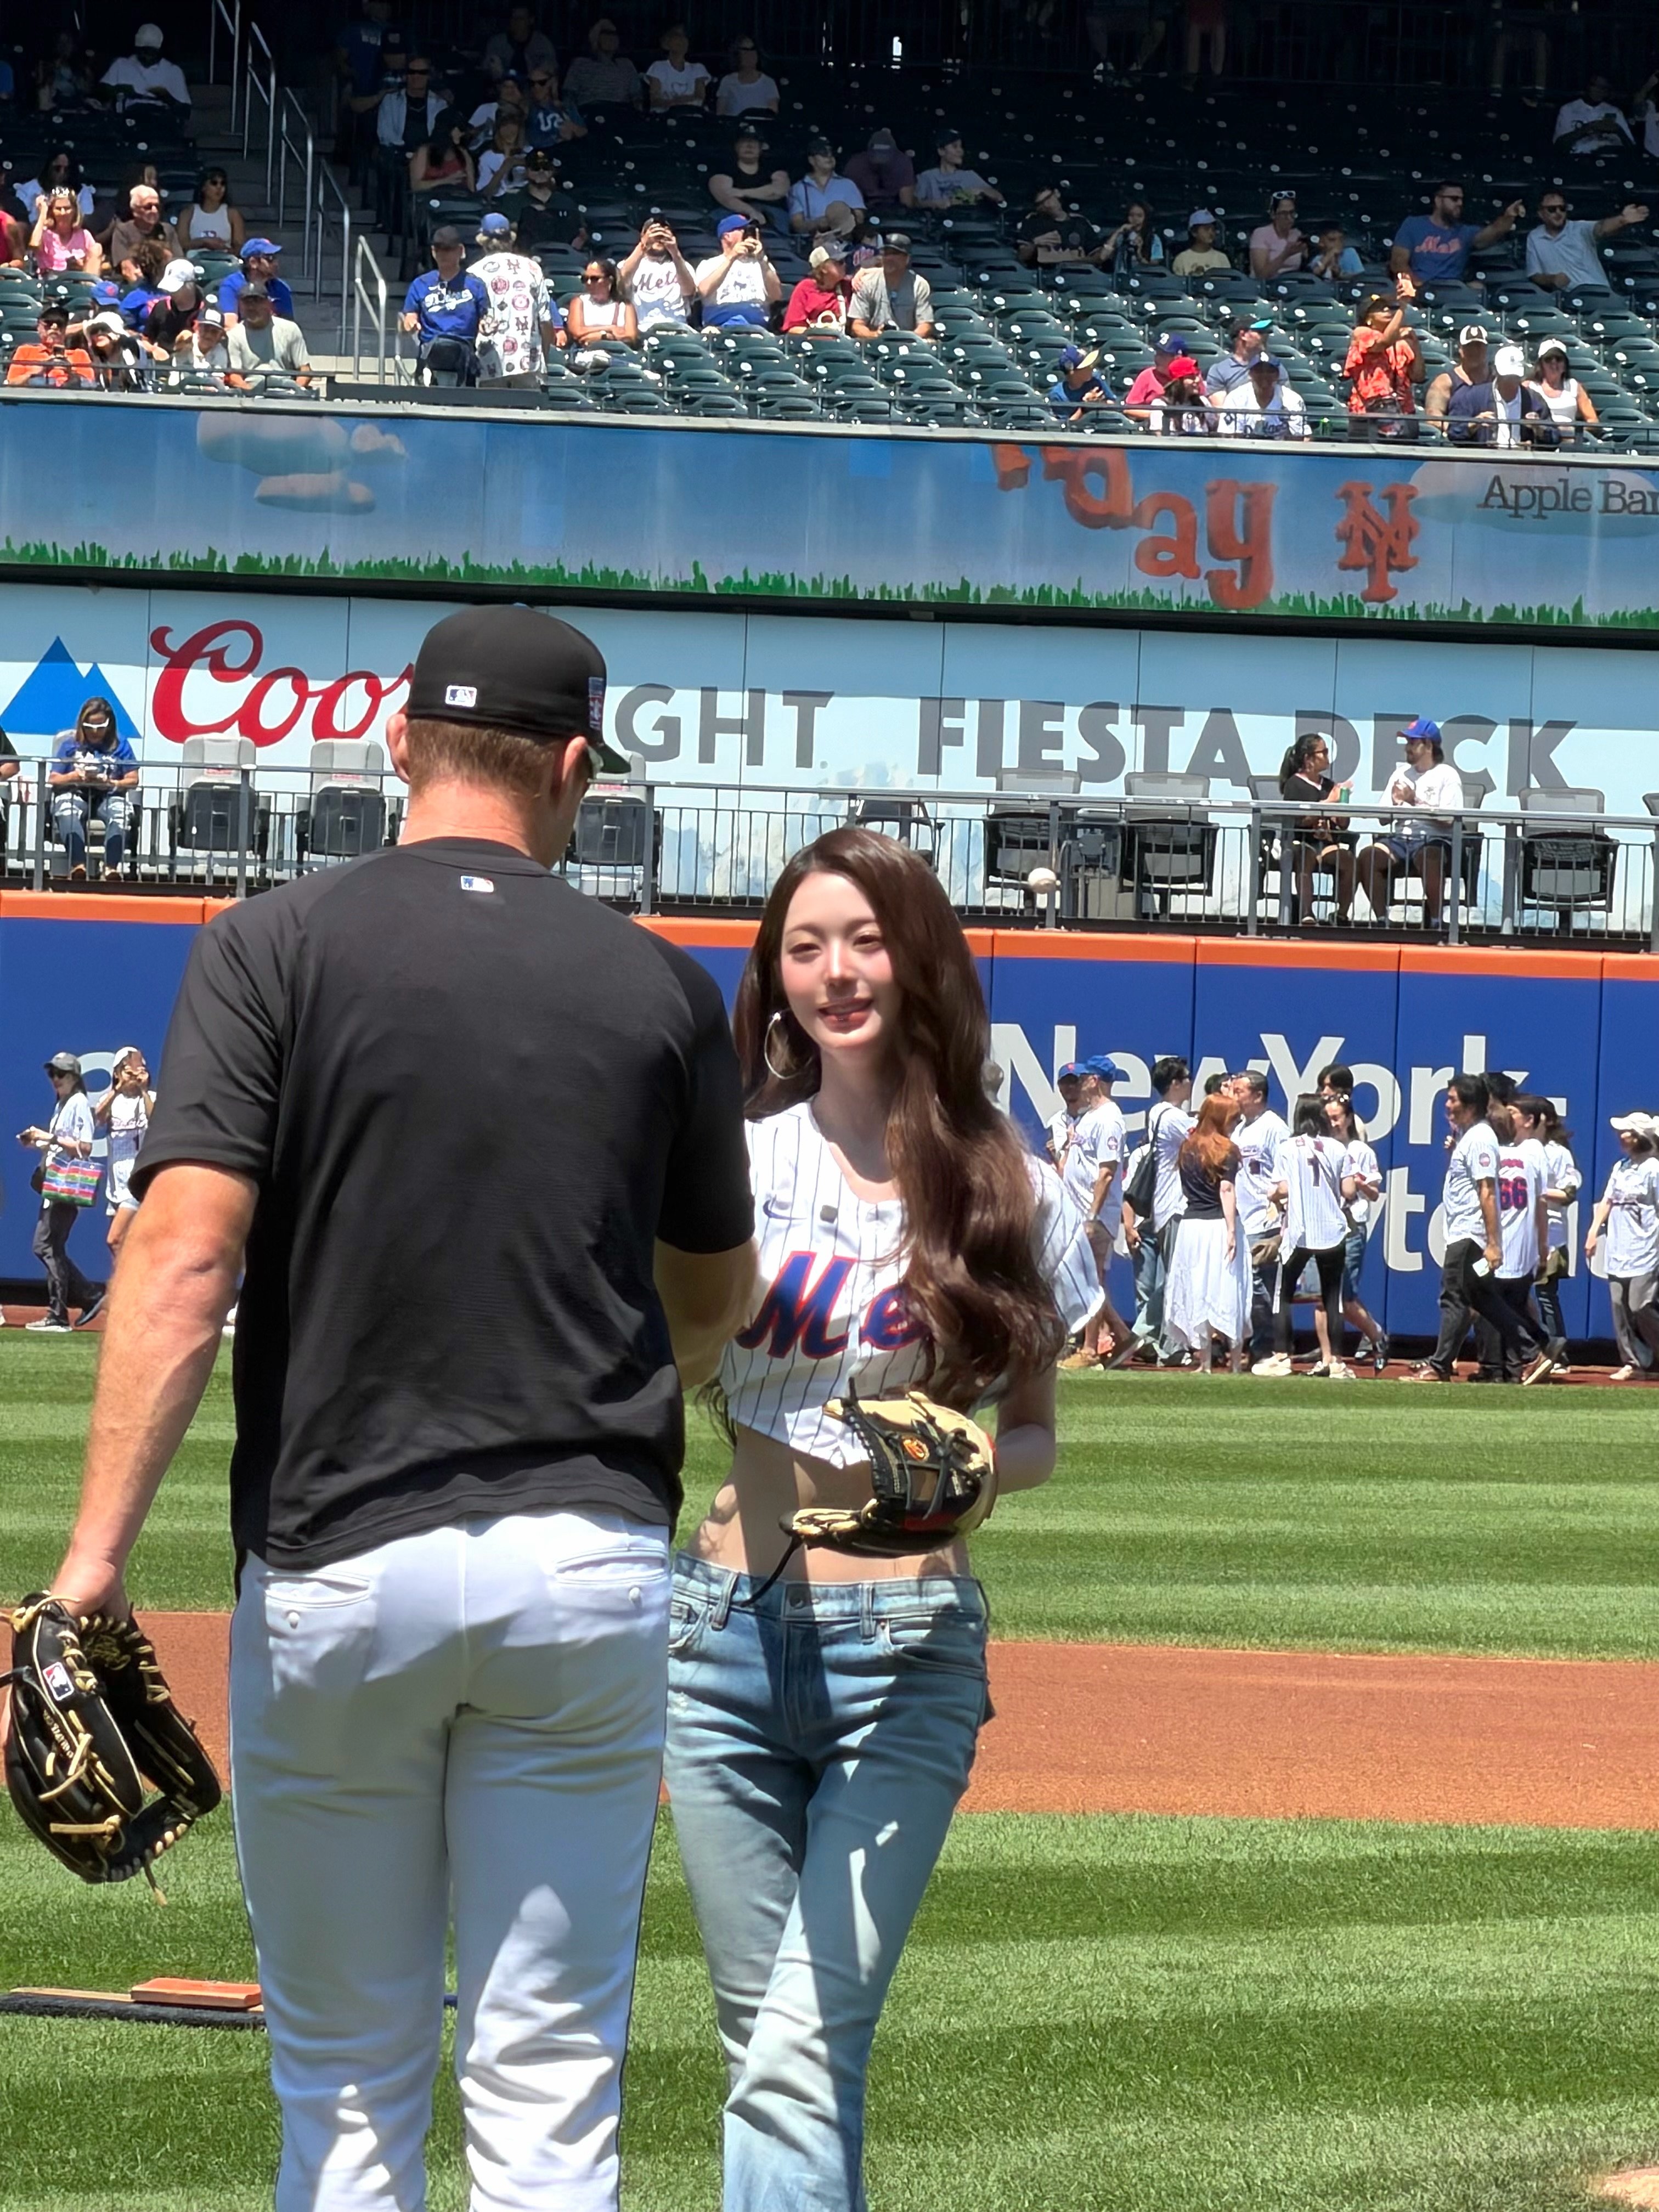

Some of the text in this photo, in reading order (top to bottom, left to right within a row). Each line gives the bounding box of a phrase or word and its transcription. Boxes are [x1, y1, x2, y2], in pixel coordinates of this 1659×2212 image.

[991, 443, 1278, 610] day
[1476, 475, 1593, 519] Apple
[150, 619, 414, 748] Coo
[614, 683, 834, 769] GHT
[917, 696, 1252, 787] FIESTA
[734, 1250, 934, 1359] Me
